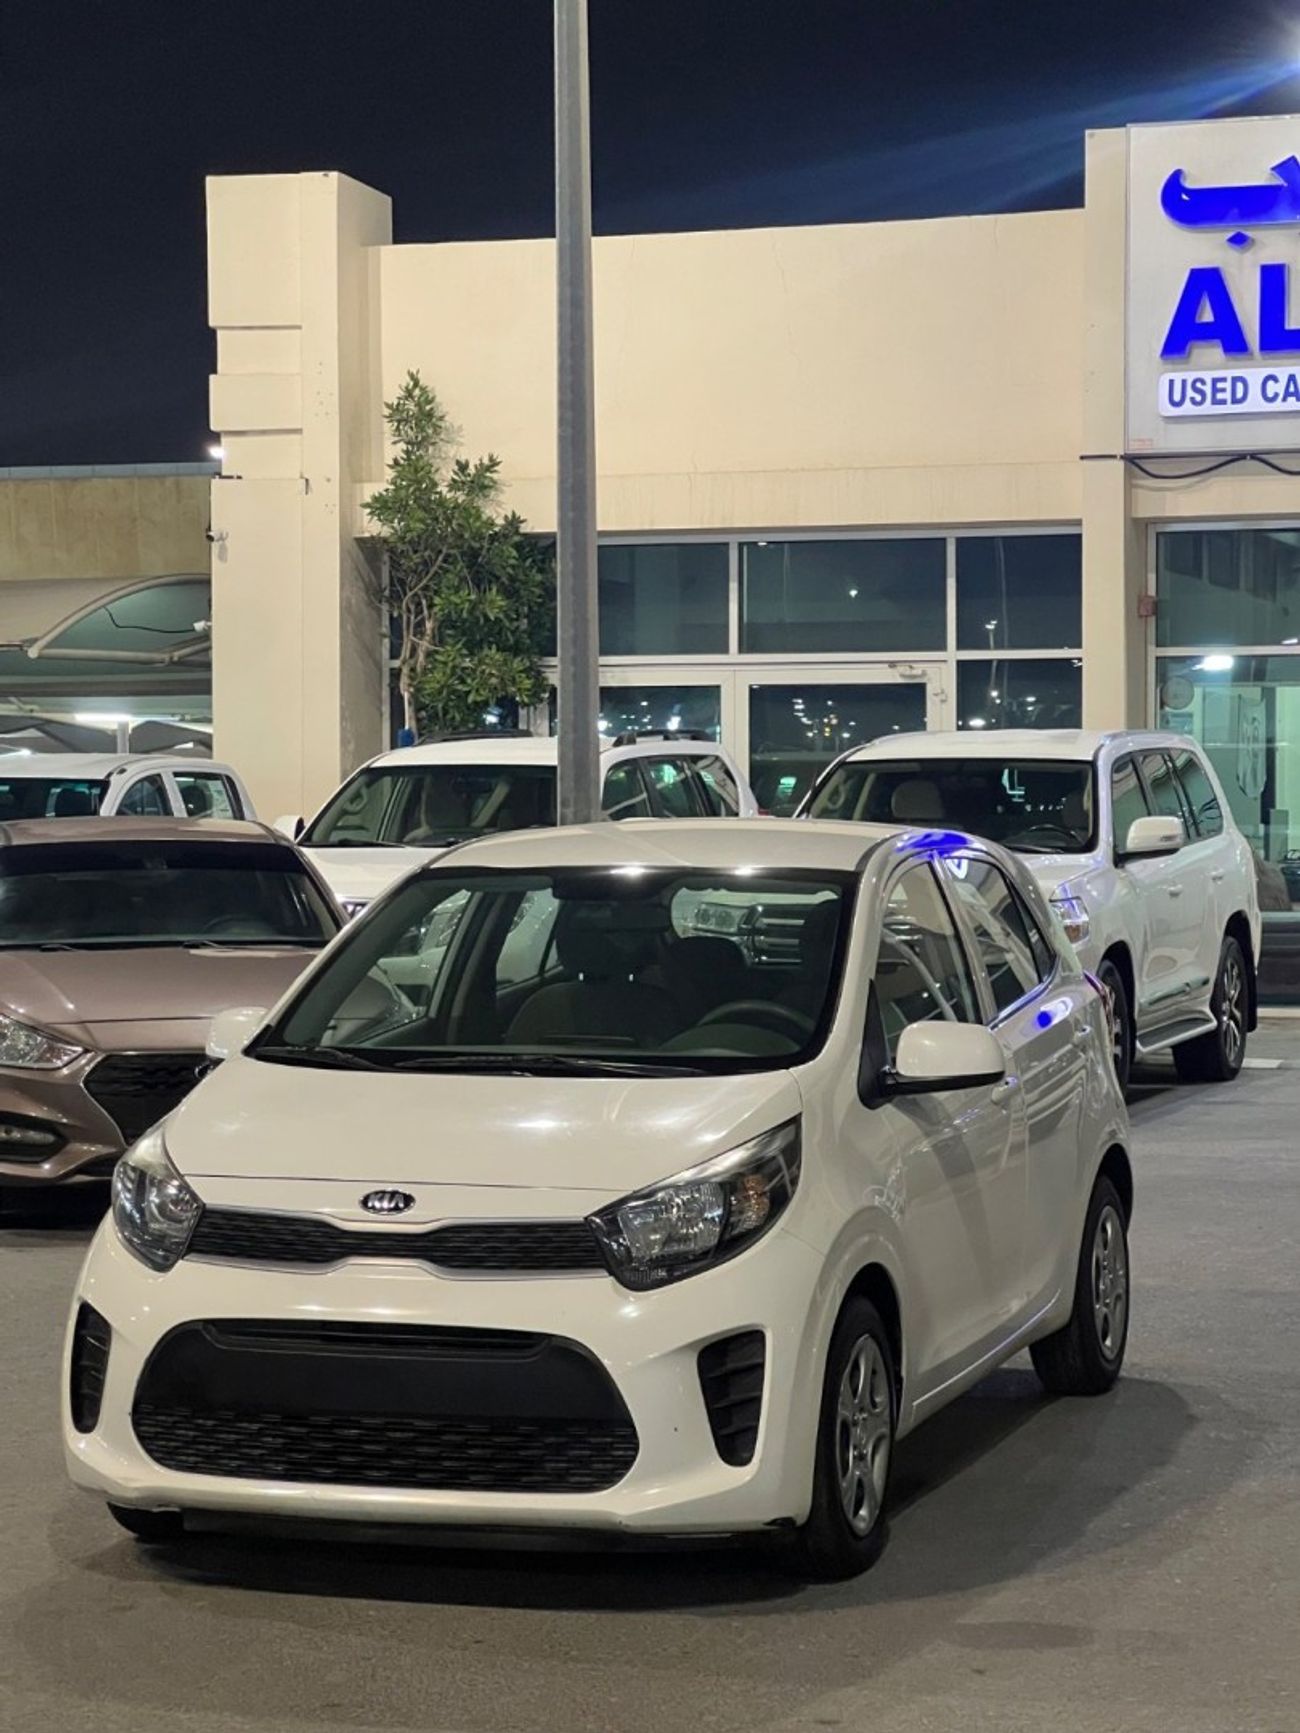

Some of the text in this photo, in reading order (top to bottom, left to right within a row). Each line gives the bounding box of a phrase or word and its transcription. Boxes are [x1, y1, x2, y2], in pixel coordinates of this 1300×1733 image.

[1160, 263, 1300, 357] AL
[1168, 373, 1300, 408] USED CA
[365, 1191, 406, 1209] KIA
